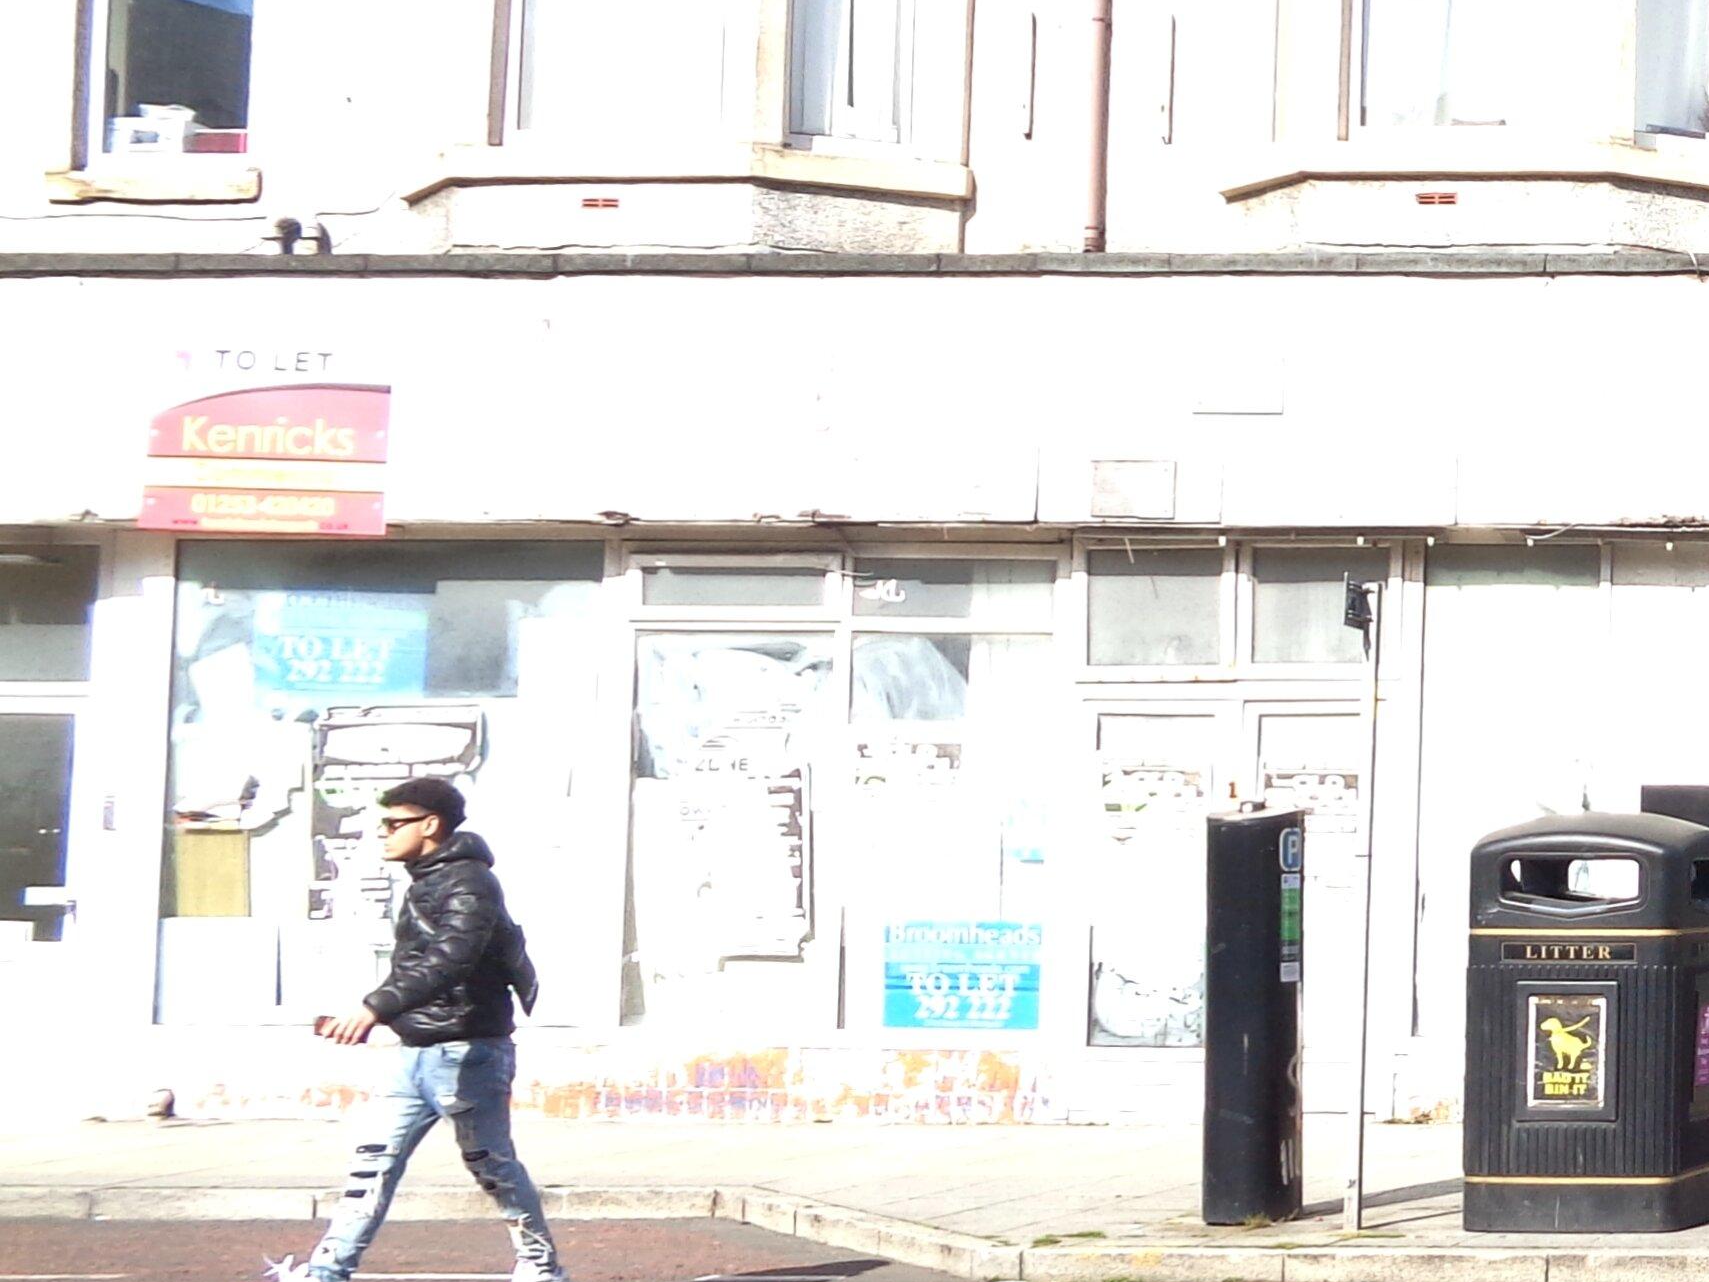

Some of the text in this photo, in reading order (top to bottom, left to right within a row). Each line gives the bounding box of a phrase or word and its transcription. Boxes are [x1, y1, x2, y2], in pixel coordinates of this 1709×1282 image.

[215, 350, 333, 371] TO LET
[181, 415, 356, 457] Kenricks
[278, 635, 323, 659] TO
[1526, 945, 1612, 959] LITTER
[905, 972, 1020, 997] TO LET
